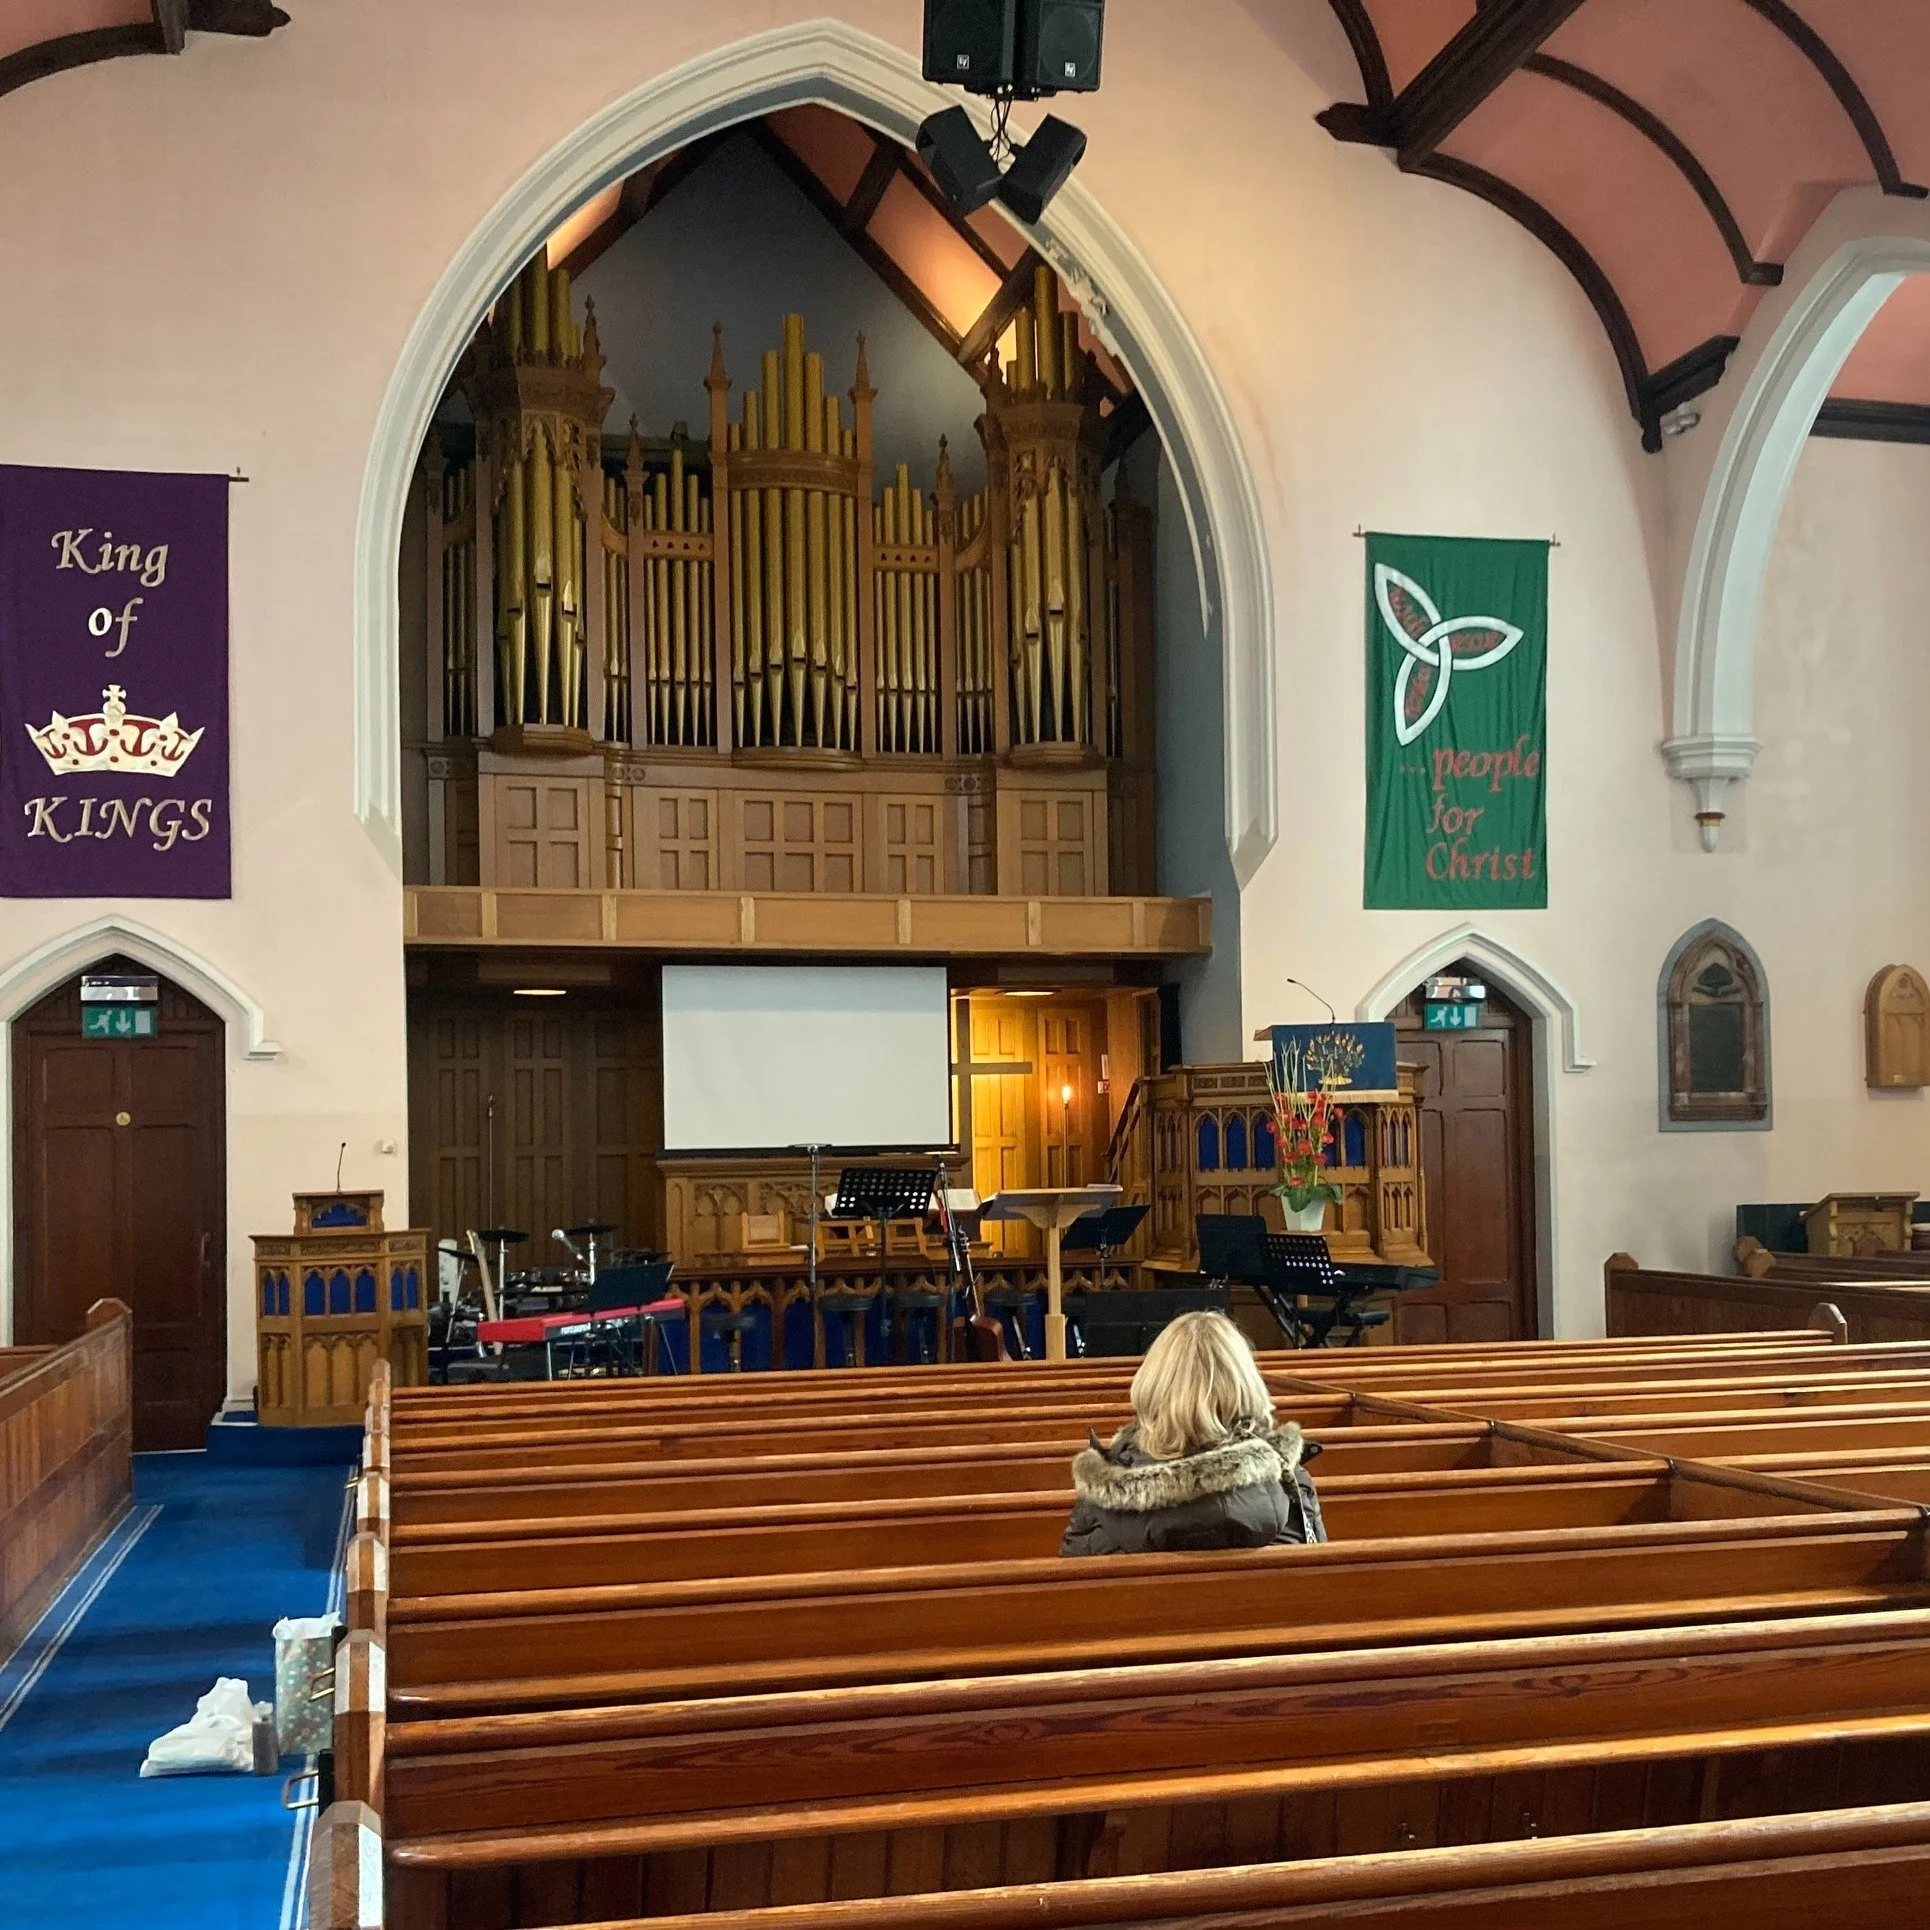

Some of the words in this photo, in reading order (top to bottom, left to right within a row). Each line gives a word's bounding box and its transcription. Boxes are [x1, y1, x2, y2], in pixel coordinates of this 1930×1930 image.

[51, 528, 168, 587] King
[88, 597, 143, 657] of
[24, 796, 212, 851] KINGS
[1426, 792, 1485, 834] for
[1425, 836, 1536, 881] Christ
